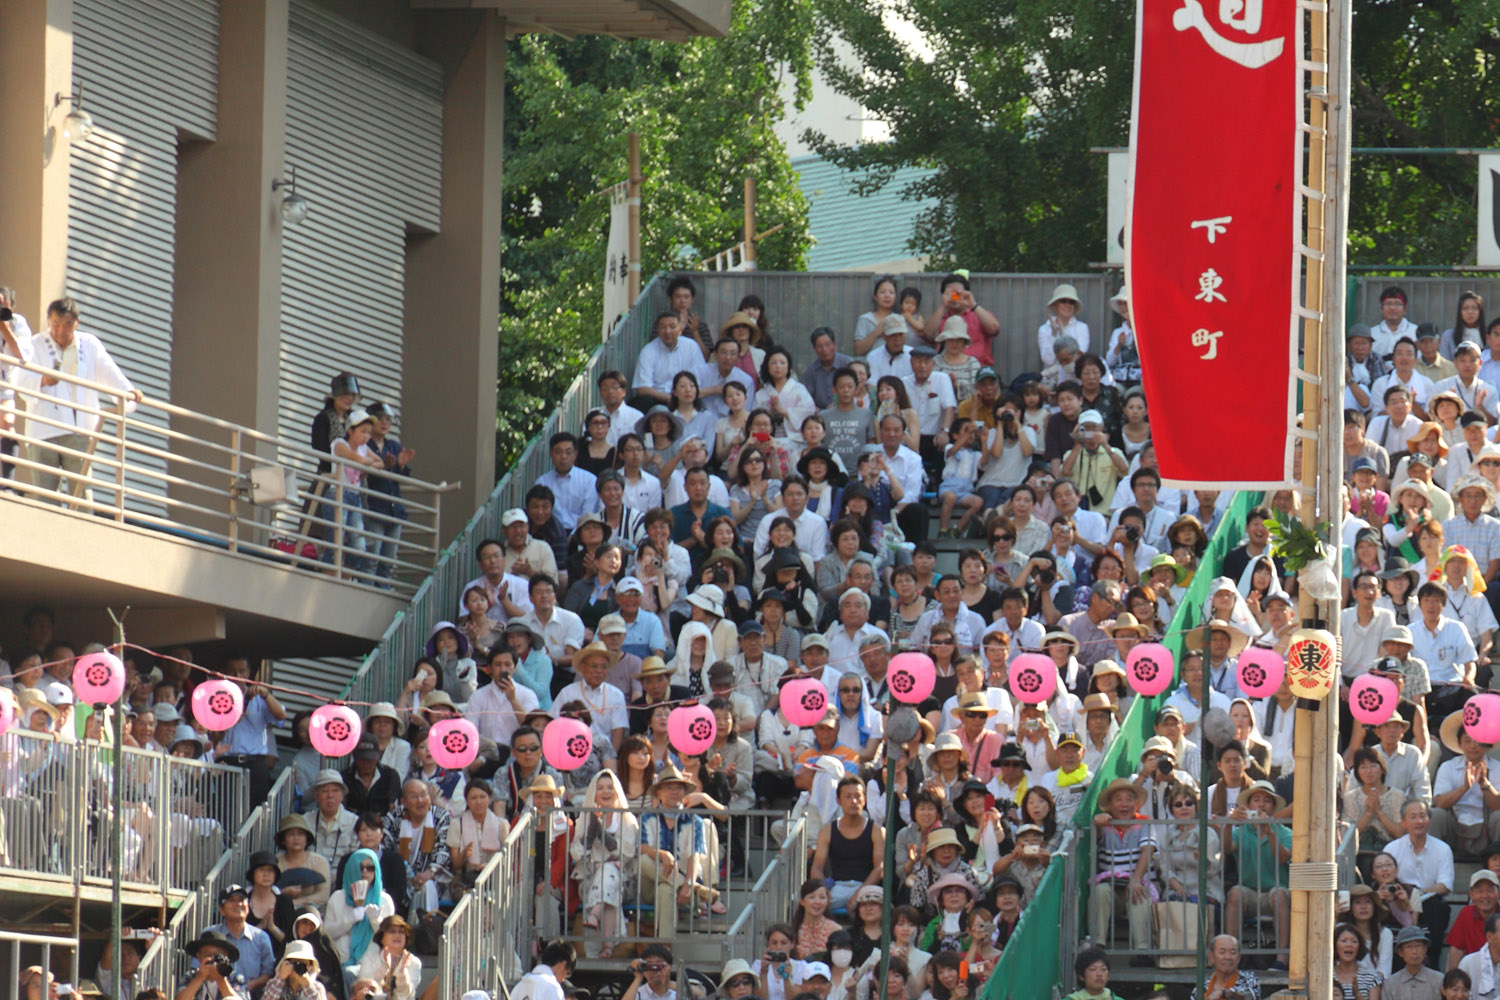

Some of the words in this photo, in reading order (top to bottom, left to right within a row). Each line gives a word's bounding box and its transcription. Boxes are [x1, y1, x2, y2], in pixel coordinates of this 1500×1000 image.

[1190, 215, 1233, 361] 下東町
[1298, 643, 1322, 672] 東
